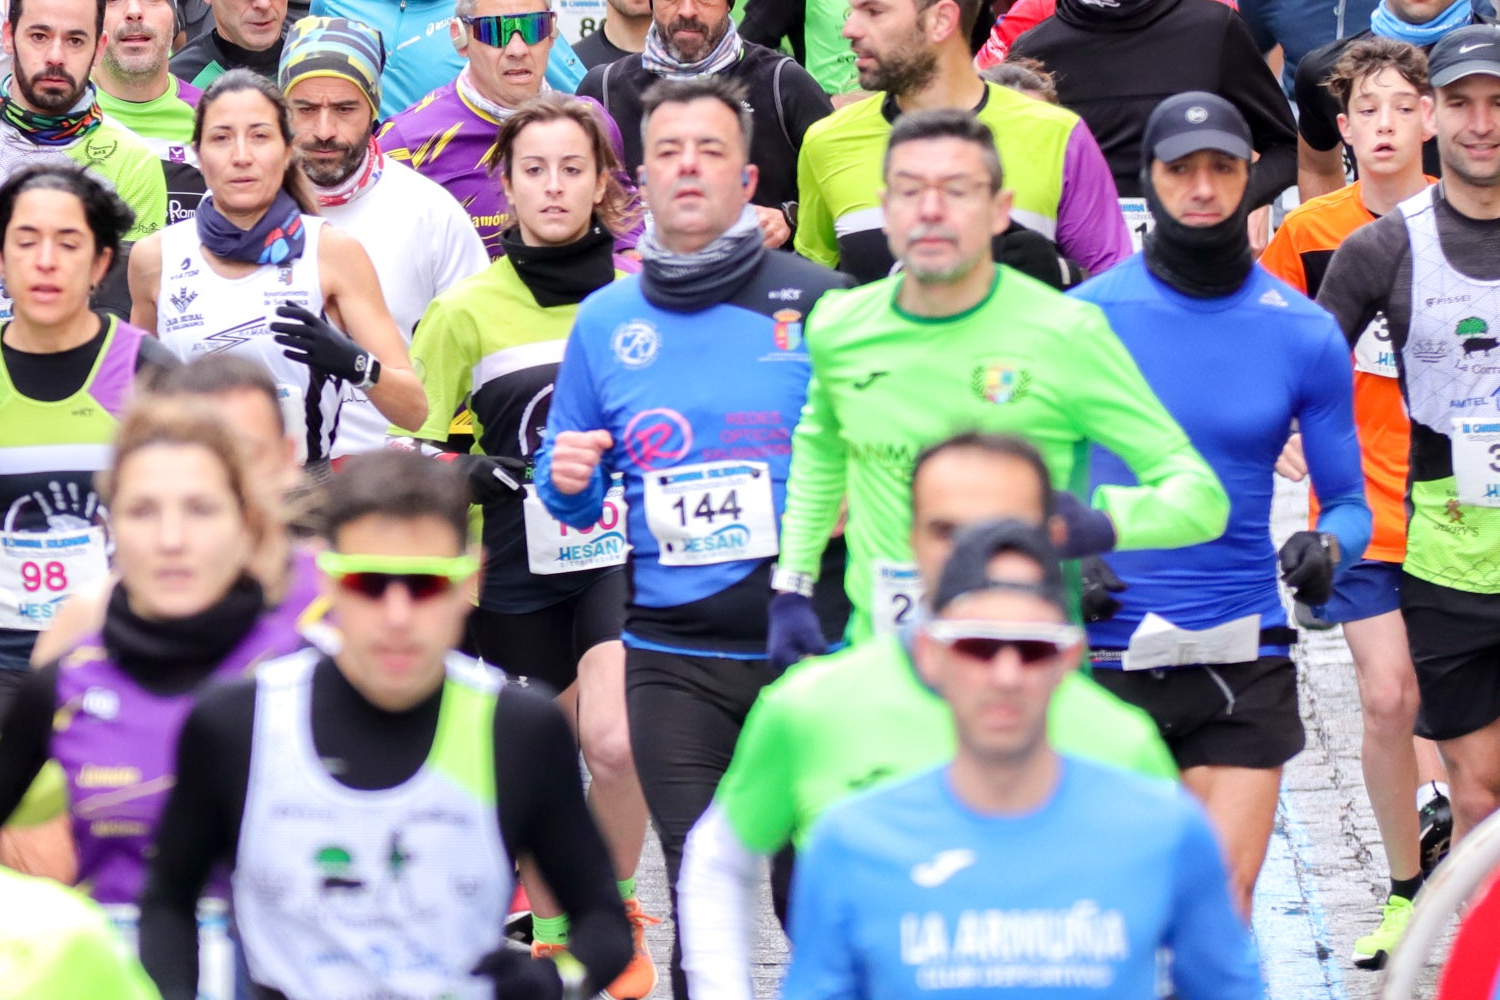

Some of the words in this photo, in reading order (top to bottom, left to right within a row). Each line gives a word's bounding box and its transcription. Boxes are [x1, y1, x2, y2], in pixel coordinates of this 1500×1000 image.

[1450, 398, 1489, 409] AMTEL
[673, 489, 743, 527] 144
[560, 540, 619, 561] HESAN
[21, 562, 67, 592] 98
[892, 594, 913, 625] 2
[901, 912, 949, 965] LA
